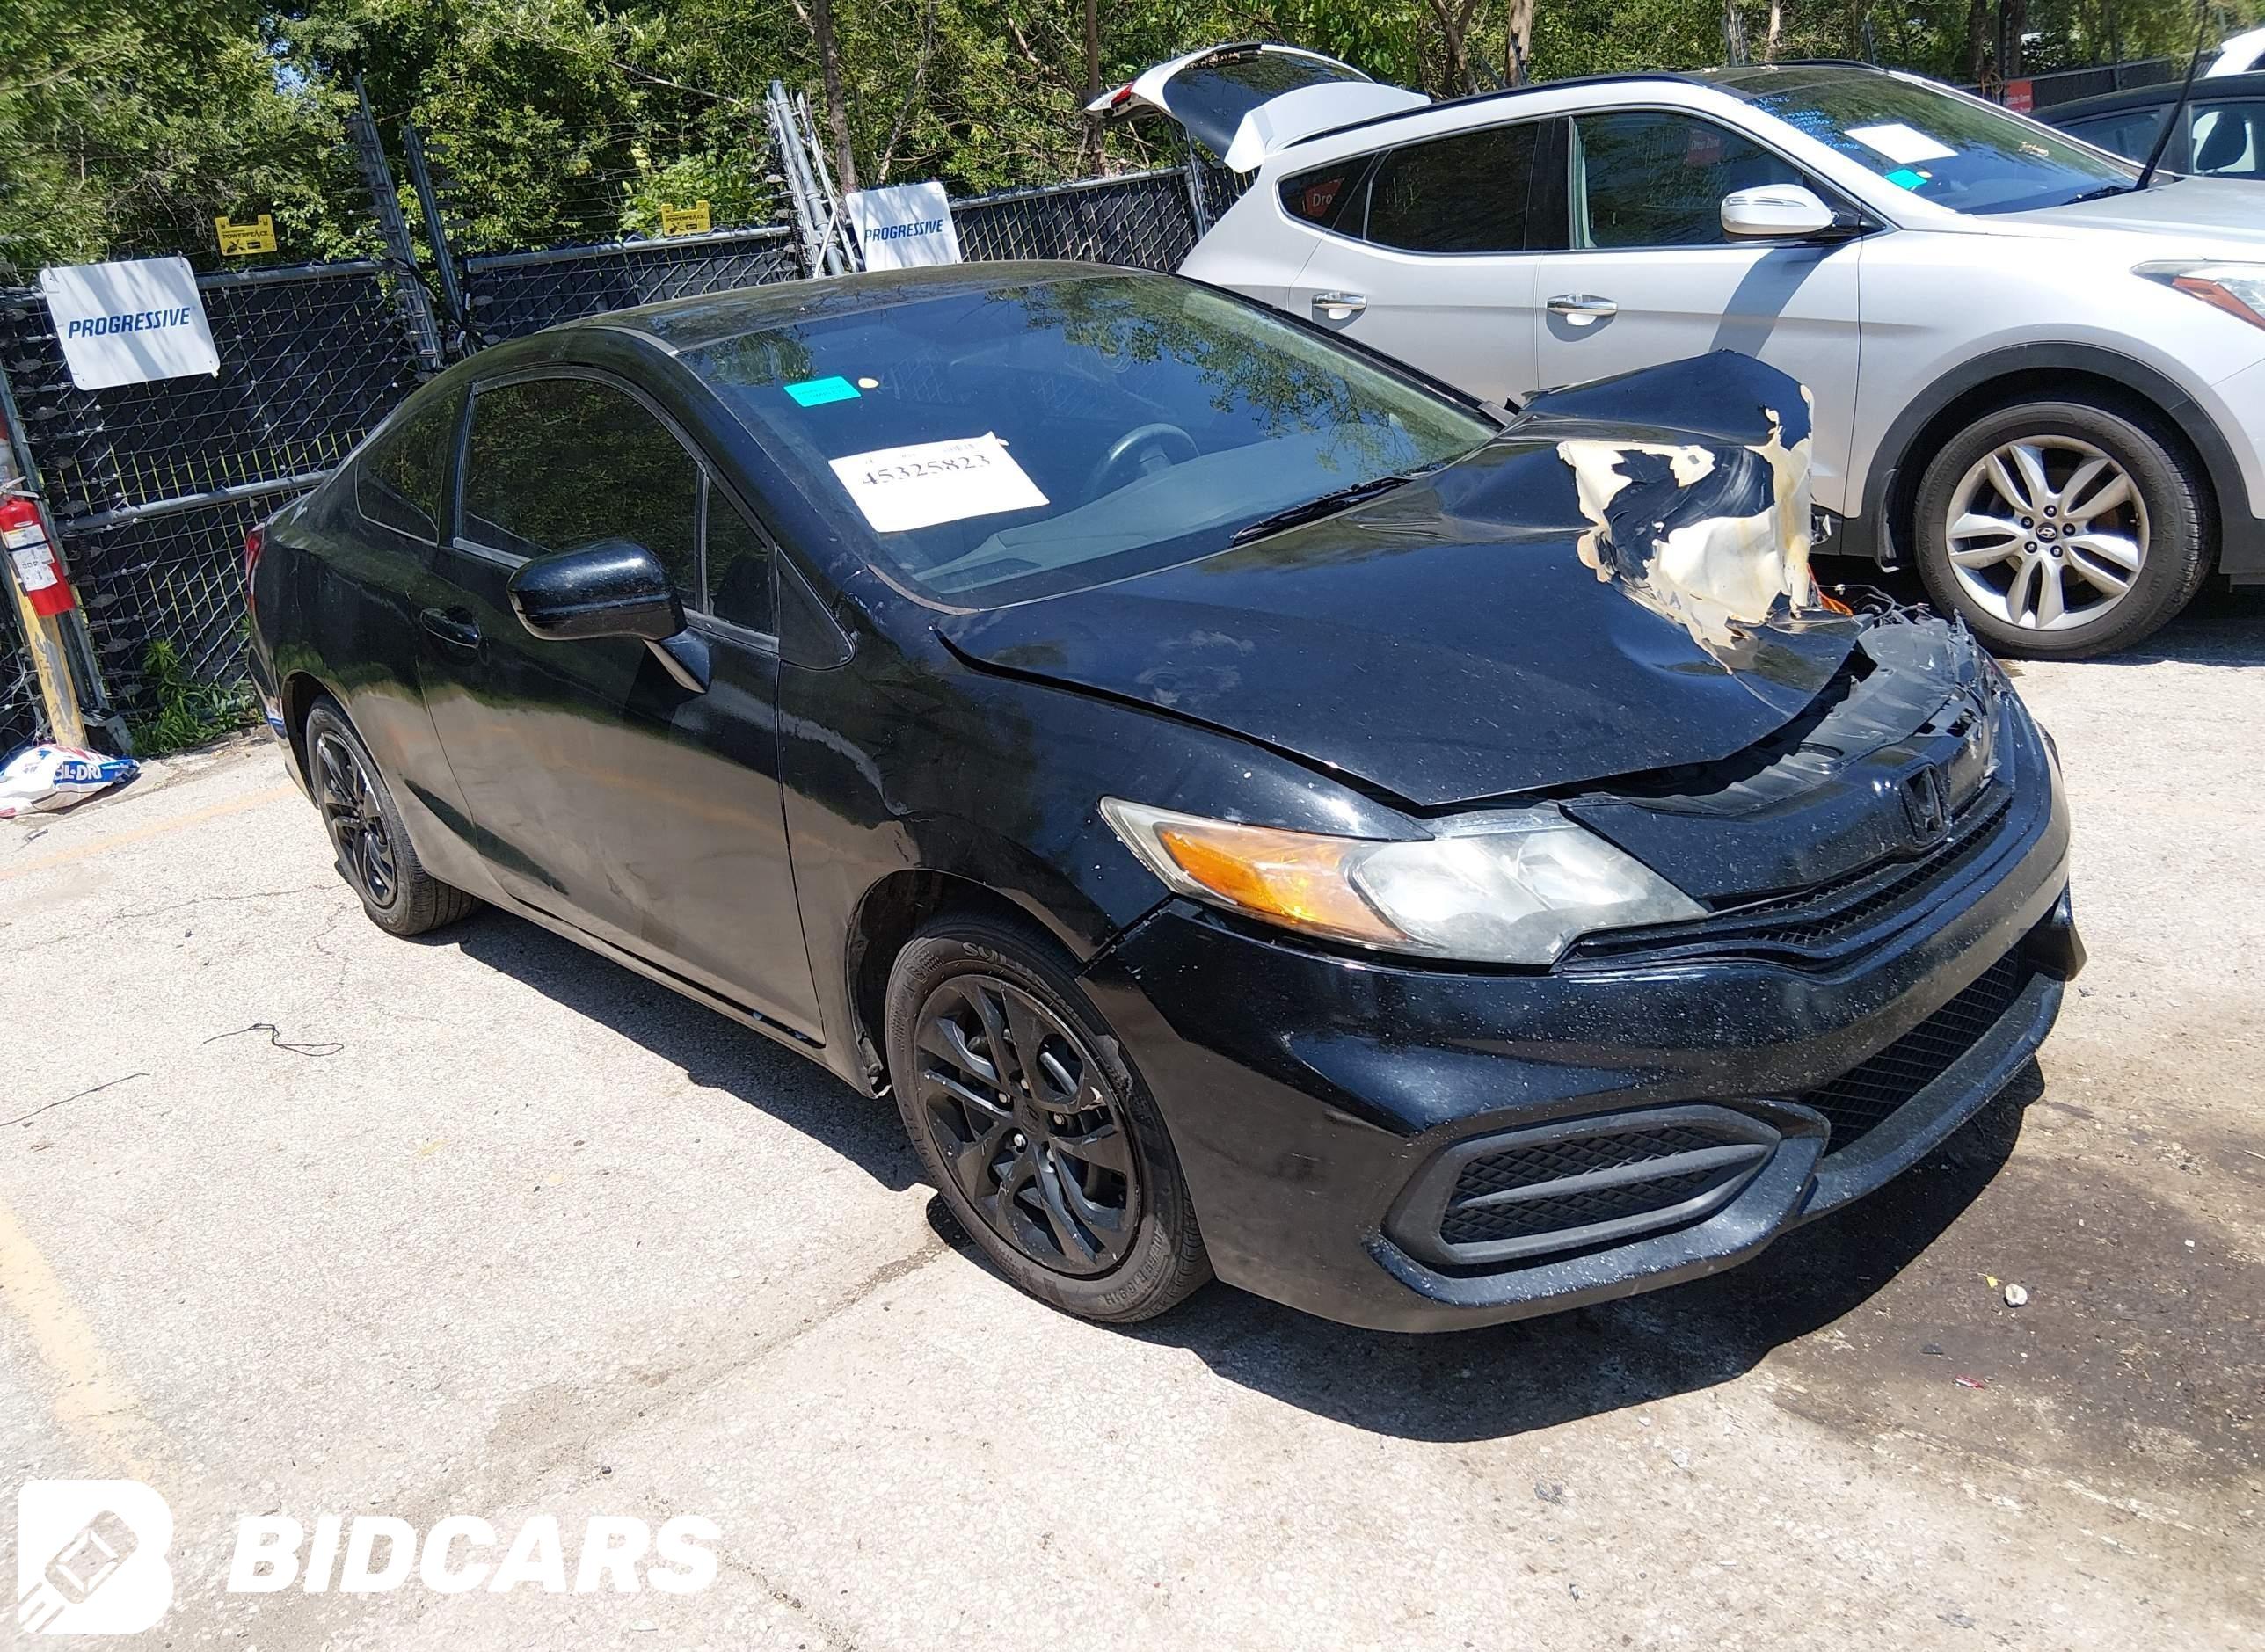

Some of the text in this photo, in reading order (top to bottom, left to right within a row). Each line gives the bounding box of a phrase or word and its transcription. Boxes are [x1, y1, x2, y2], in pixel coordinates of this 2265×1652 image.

[1313, 193, 1336, 207] Dro
[864, 219, 943, 243] PROGRESSIVE
[68, 307, 190, 339] PROGRESSIVE
[863, 455, 991, 484] 45325823
